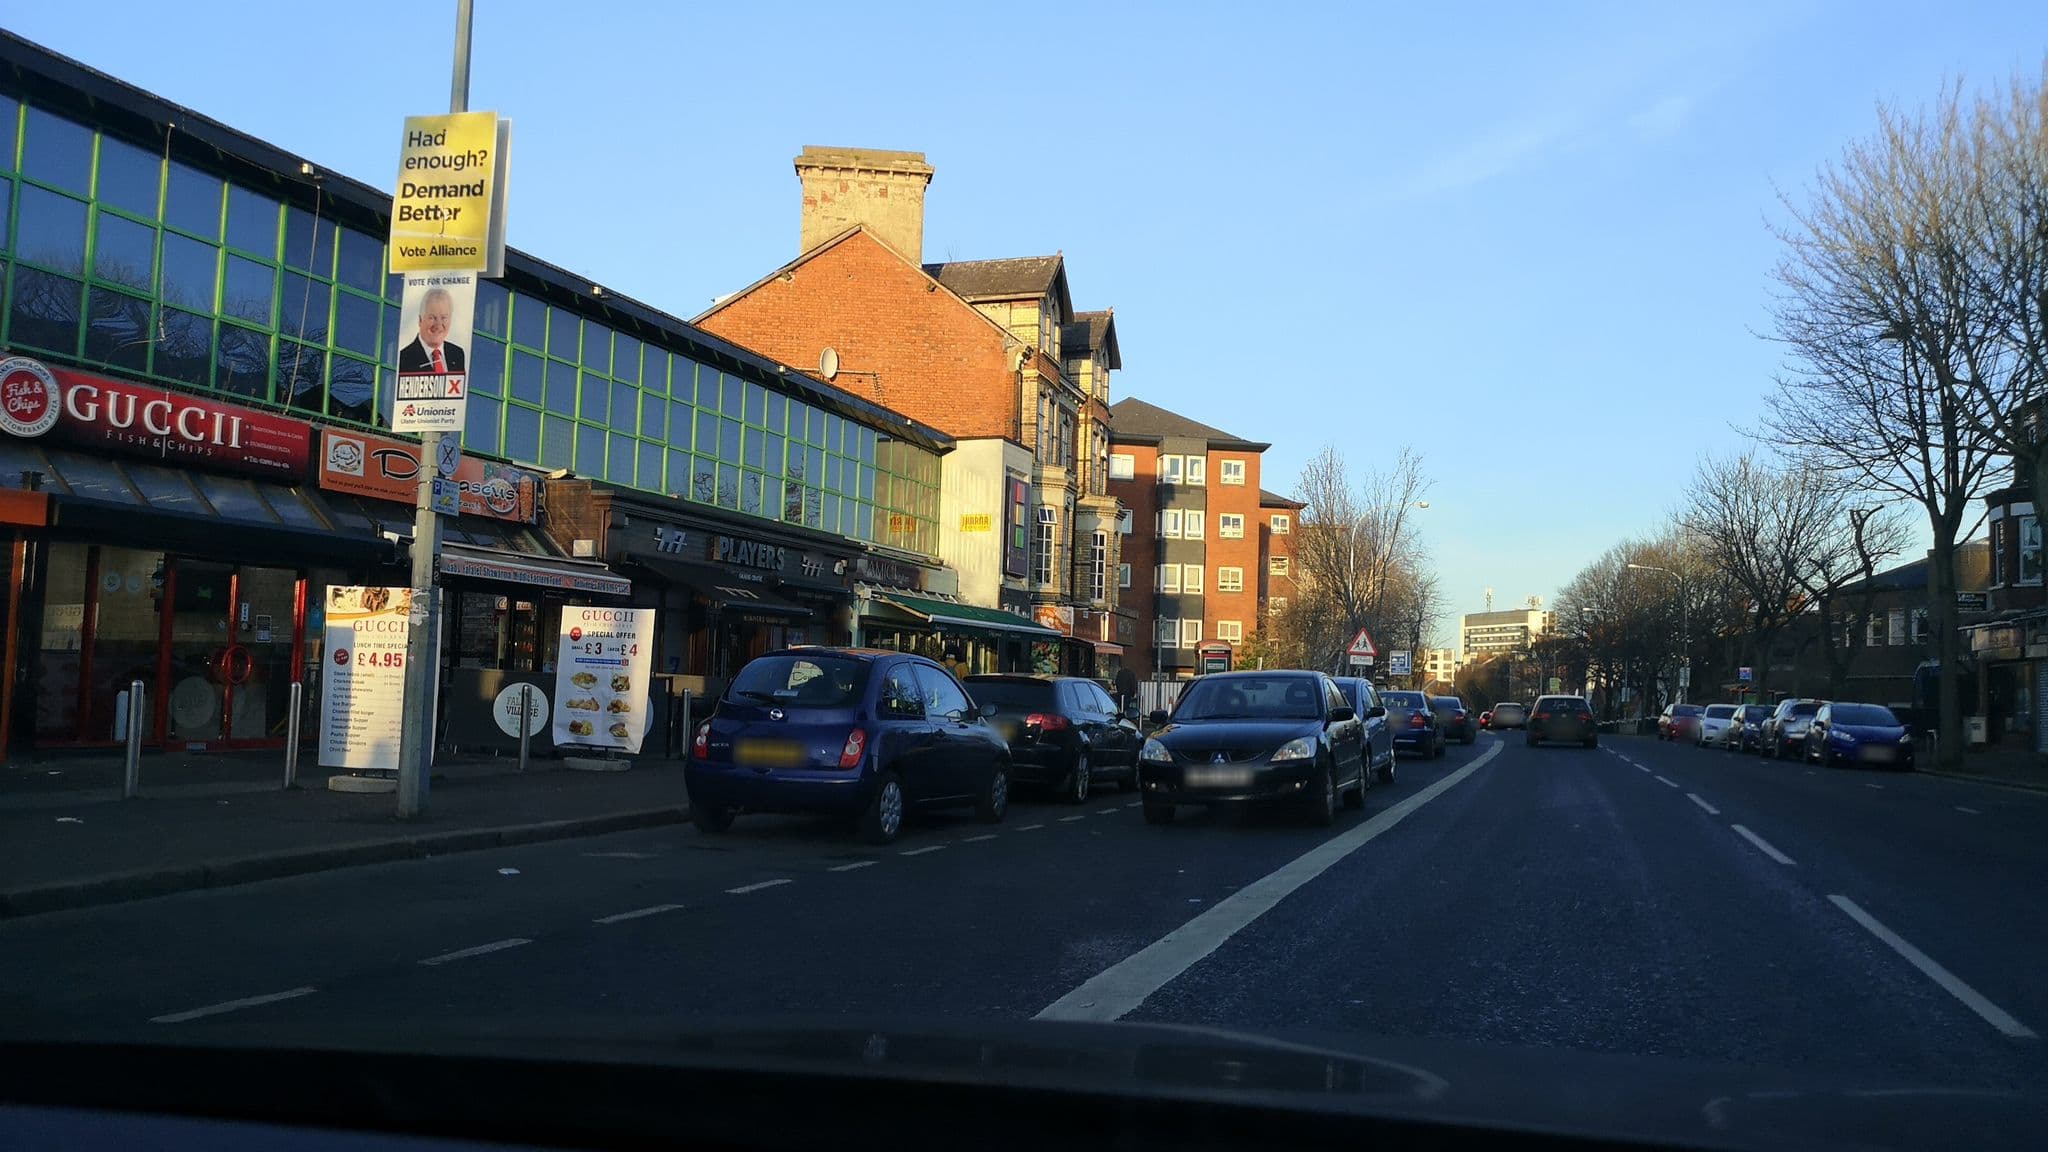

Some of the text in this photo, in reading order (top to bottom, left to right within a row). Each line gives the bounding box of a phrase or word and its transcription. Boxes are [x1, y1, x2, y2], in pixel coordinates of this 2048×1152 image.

[408, 129, 447, 148] Had
[405, 150, 488, 171] enough?
[401, 179, 485, 199] Demand
[398, 205, 462, 222] Better
[399, 244, 478, 257] Vote Alliance
[408, 276, 471, 287] VOTE FOR CHANGE
[6, 380, 43, 398] Fish &
[398, 375, 446, 400] HENDERSON
[7, 396, 41, 414] Chips
[416, 406, 457, 417] Unionist
[66, 384, 243, 449] GUCCII
[400, 418, 416, 426] Ulster
[441, 417, 456, 426] Party
[106, 429, 212, 456] FISH & CHIPS
[371, 448, 519, 502] Dascus
[719, 535, 786, 571] PLAYERS
[582, 609, 634, 623] GUCCII
[352, 619, 407, 633] GUCCI
[587, 630, 614, 639] SPECIAL
[615, 632, 636, 640] OFFER
[506, 696, 540, 708] FALEL
[505, 705, 540, 718] VILLGE
